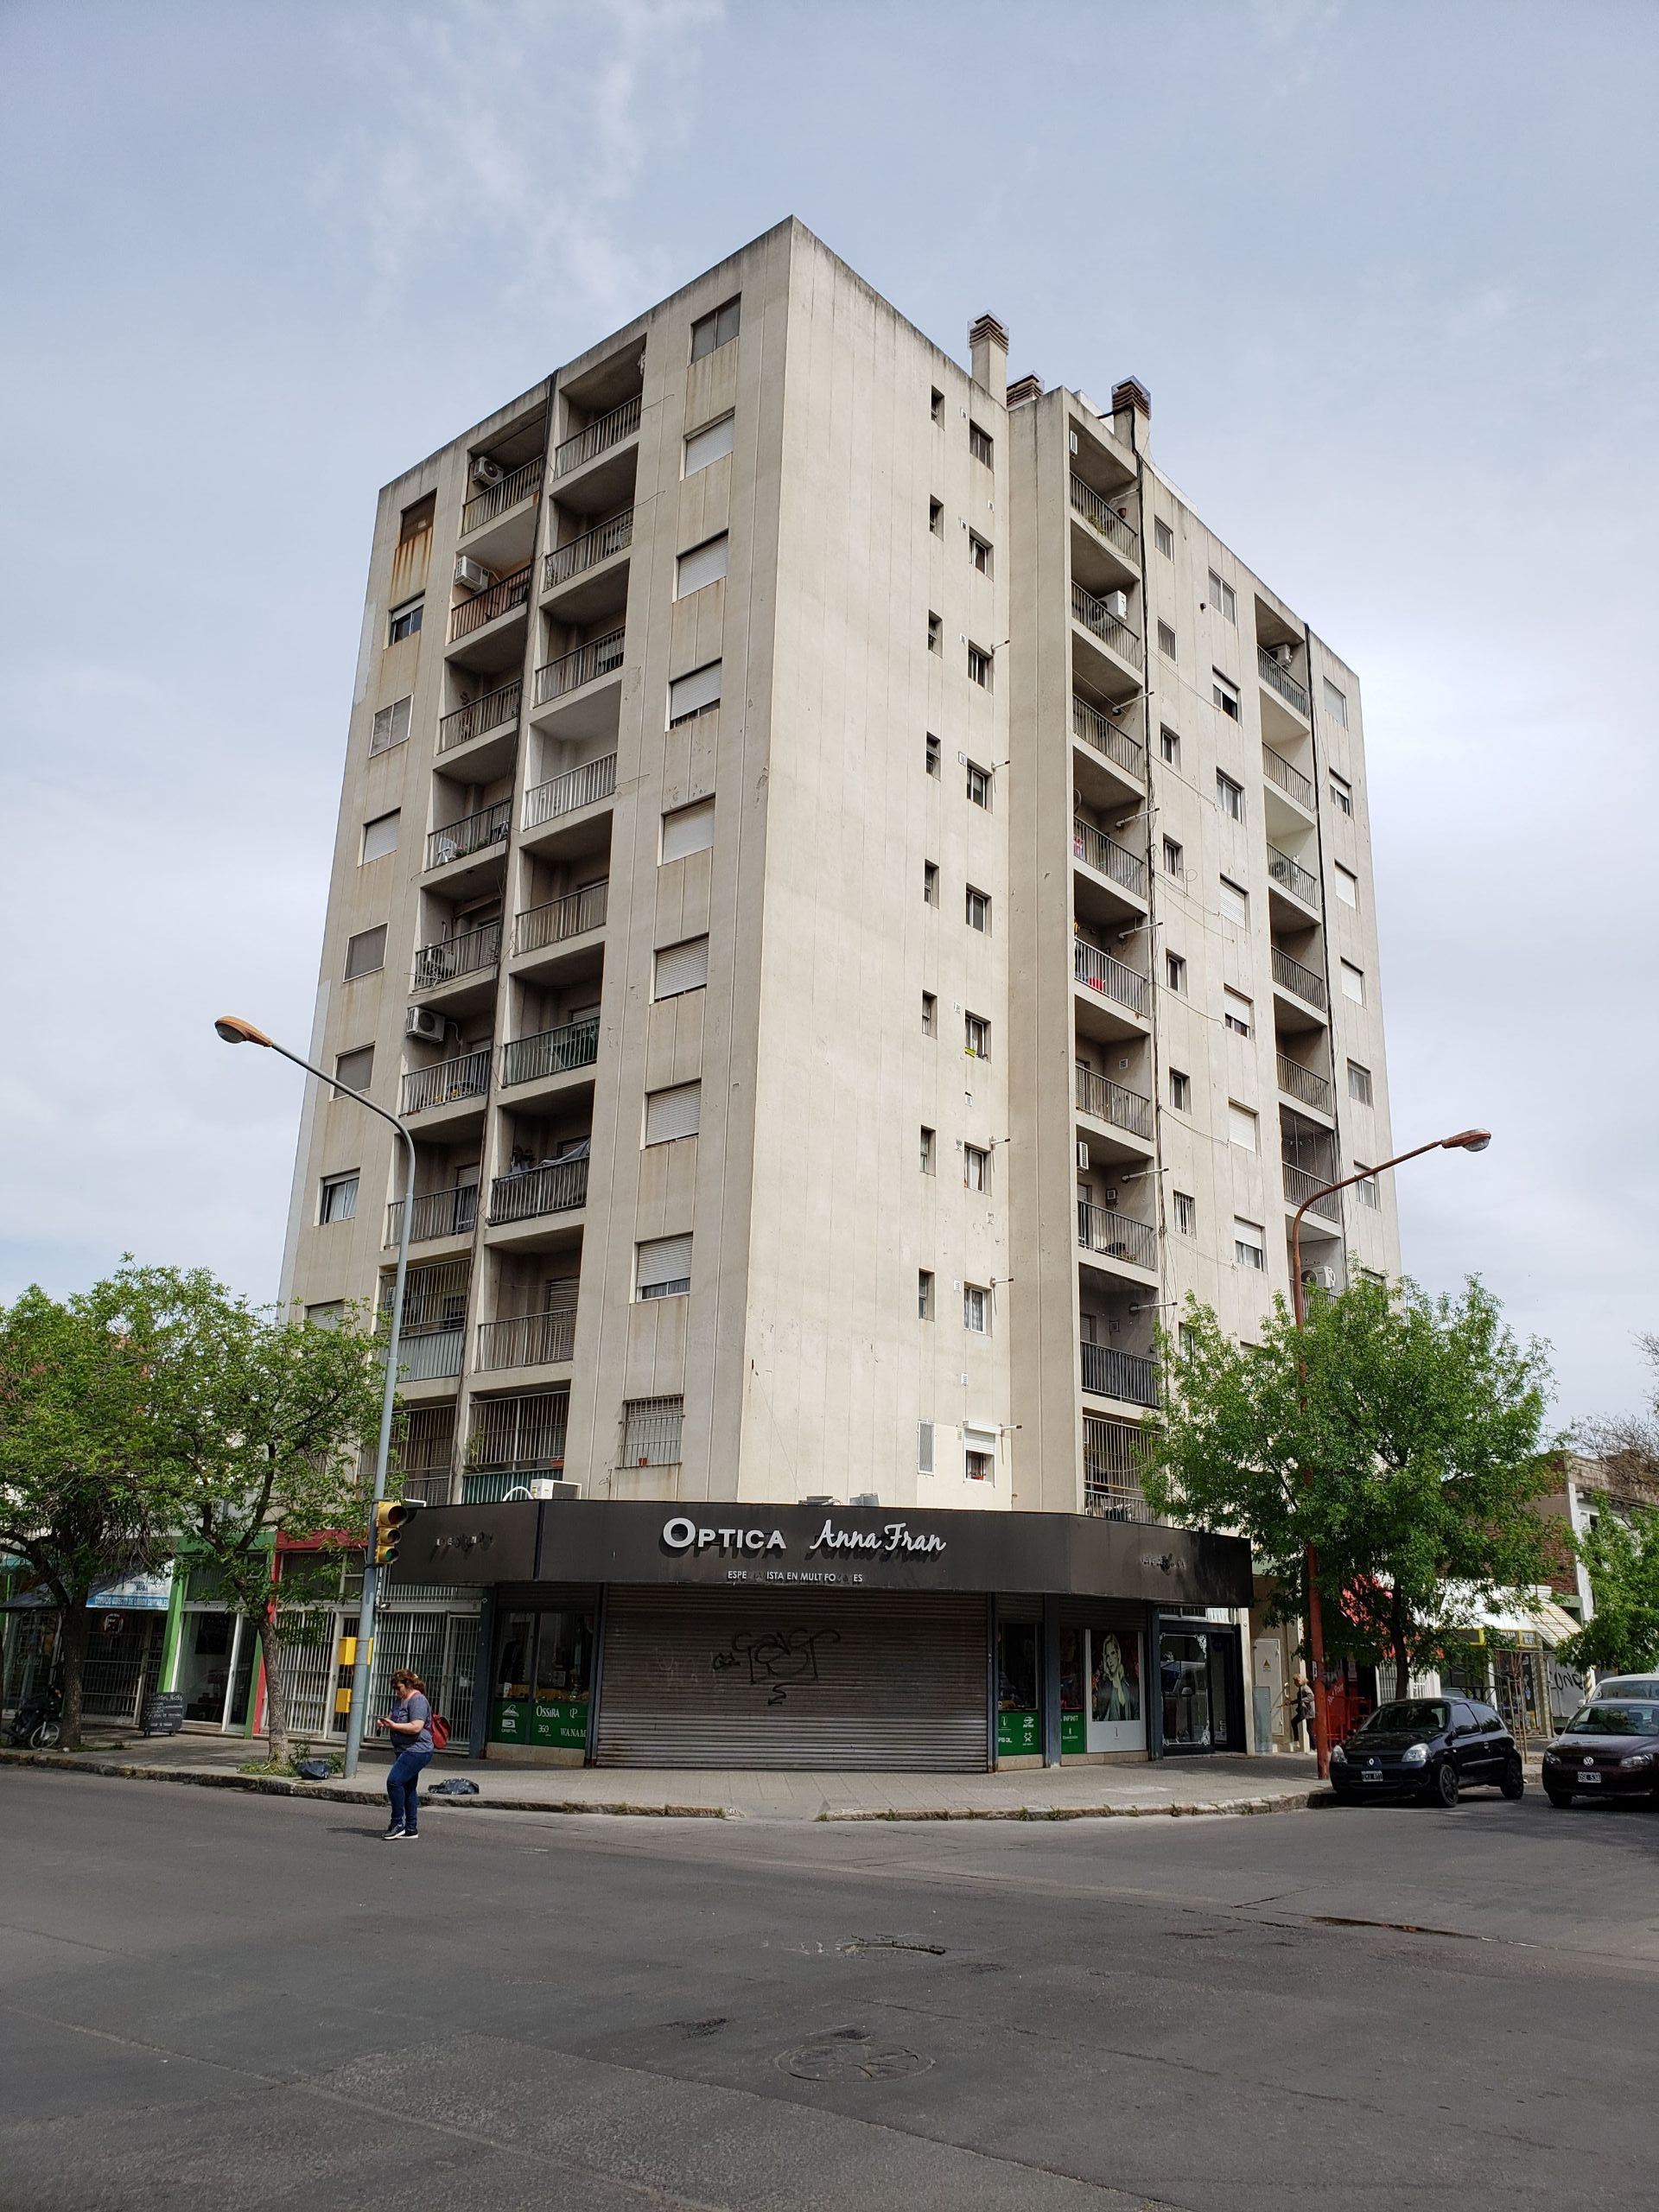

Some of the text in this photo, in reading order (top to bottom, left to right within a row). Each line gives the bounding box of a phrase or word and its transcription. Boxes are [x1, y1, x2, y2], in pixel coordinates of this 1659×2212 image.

[663, 1517, 947, 1552] OPTICA Anna Fran
